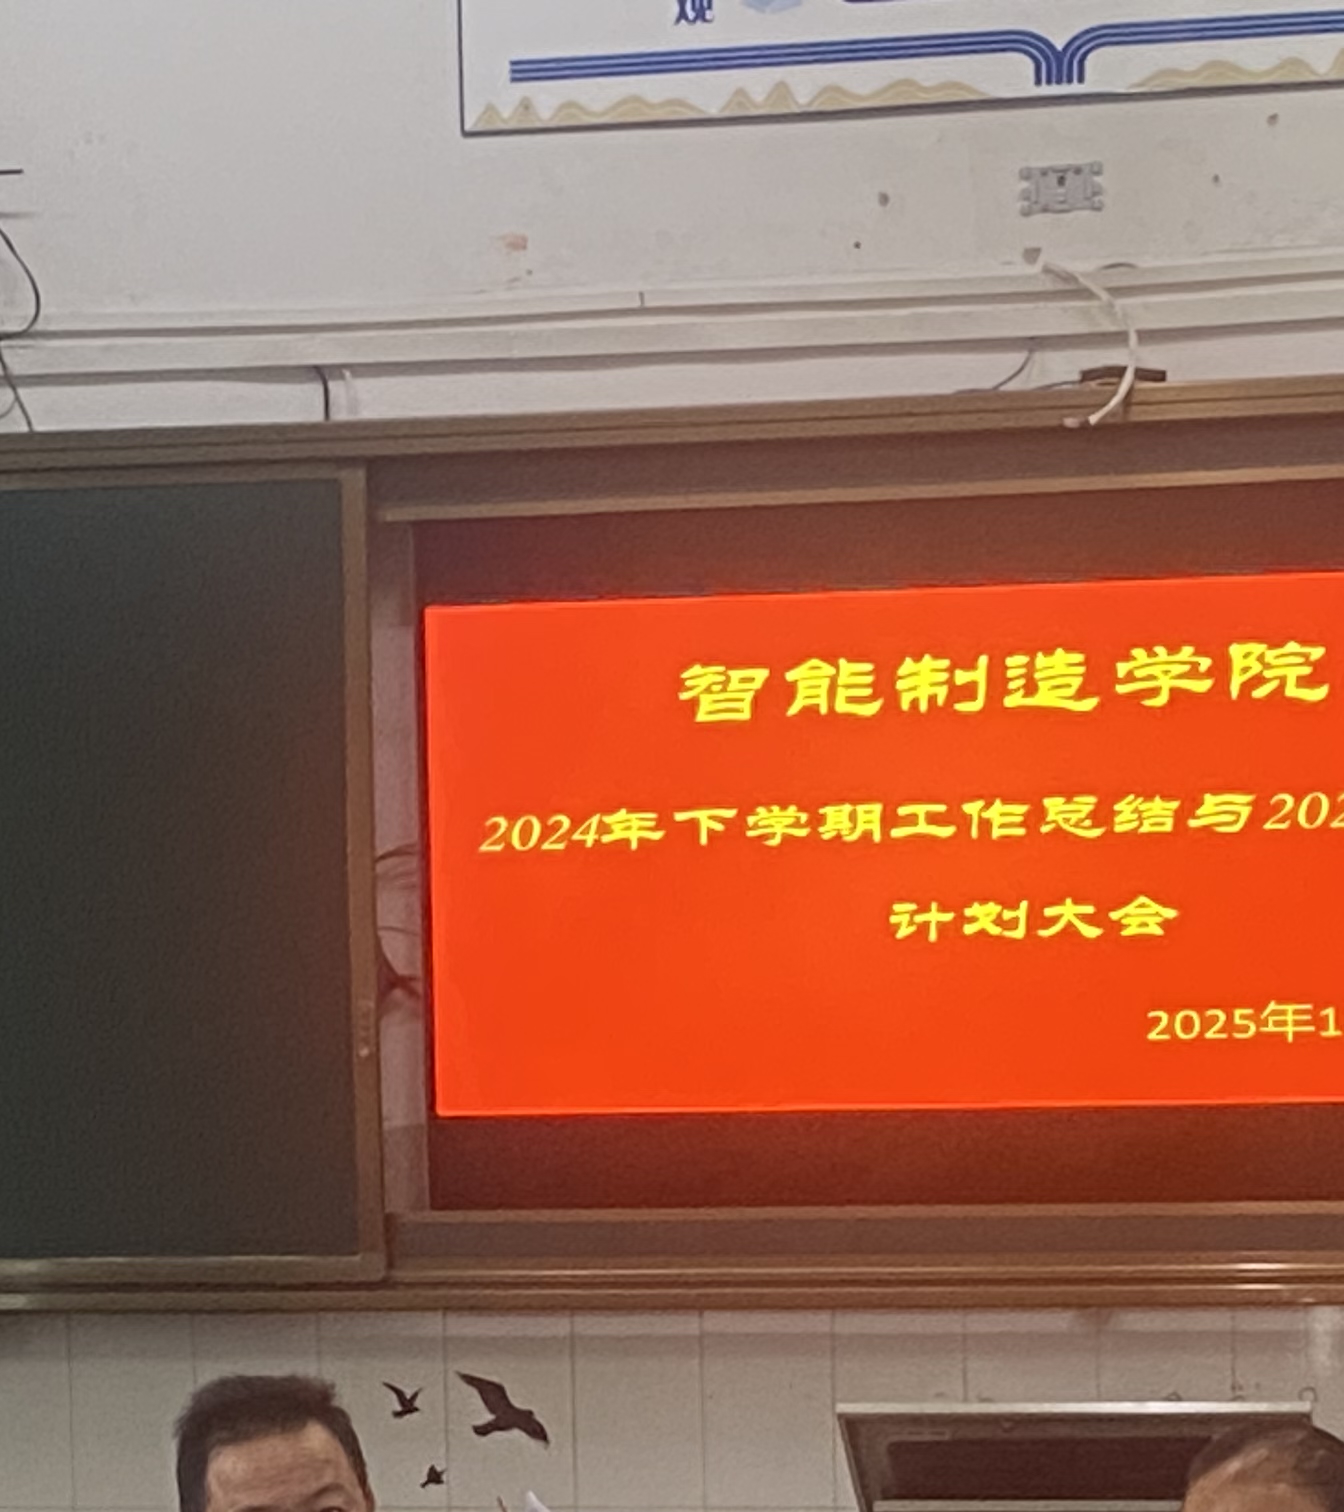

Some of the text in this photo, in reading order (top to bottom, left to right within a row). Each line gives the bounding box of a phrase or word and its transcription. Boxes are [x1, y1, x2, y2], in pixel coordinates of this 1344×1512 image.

[678, 641, 1330, 723] 智能制造学院
[889, 895, 1179, 943] 计划大会
